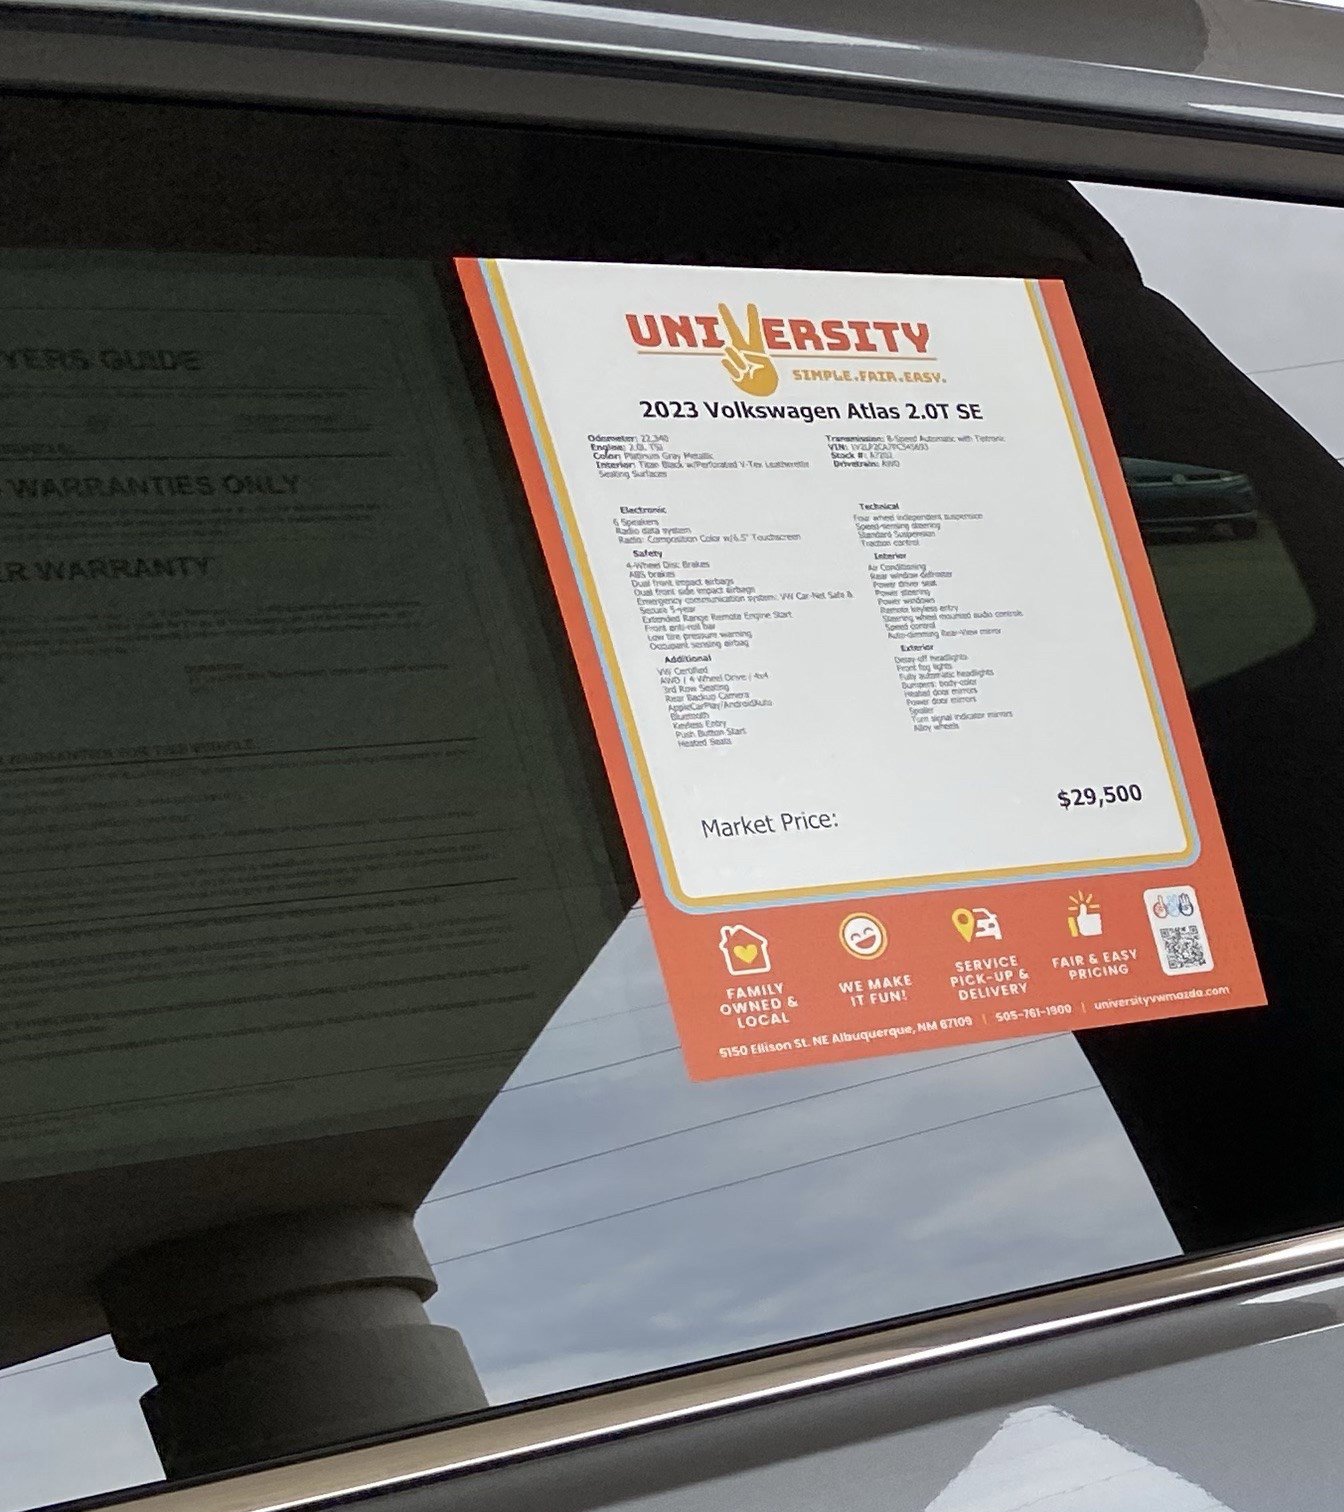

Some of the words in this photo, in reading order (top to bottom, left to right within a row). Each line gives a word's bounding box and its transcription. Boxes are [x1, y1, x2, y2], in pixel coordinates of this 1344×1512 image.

[100, 349, 201, 371] GUIDE
[639, 400, 699, 418] 2023
[703, 401, 841, 423] Volkswagen
[847, 402, 900, 419] Atlas
[905, 403, 949, 419] 2.0T
[957, 404, 983, 419] SE
[7, 476, 215, 499] WARRANTIES
[222, 473, 300, 495] ONLY
[620, 506, 666, 514] Electronic
[621, 518, 659, 527] Speakers
[700, 534, 720, 542] Color
[633, 550, 662, 558] Safety
[34, 556, 211, 581] WARRANTY
[665, 655, 711, 663] Additional
[701, 813, 775, 839] Market
[781, 813, 839, 832] Price:
[1058, 784, 1142, 810] $29,500
[955, 956, 1017, 972] SERVICE
[1052, 956, 1084, 968] FAIR
[1089, 953, 1098, 964] &
[1103, 950, 1138, 964] EASY
[950, 969, 1012, 987] PICK-UP
[1018, 968, 1029, 980] &
[1069, 964, 1128, 980] PRICING
[726, 982, 784, 999] FAMILY
[839, 980, 863, 993] WE
[868, 975, 912, 990] MAKE
[959, 982, 1028, 1001] DELIVERY
[720, 998, 781, 1015] OWNED
[787, 996, 798, 1008] &
[850, 995, 864, 1007] IT
[870, 989, 906, 1004] FUN!
[737, 1012, 790, 1029] LOCAL
[719, 1046, 748, 1058] 5150
[751, 1040, 792, 1054] Ellison
[794, 1037, 809, 1049] St.
[813, 1034, 829, 1045] NE
[832, 1024, 916, 1044] Albuquerque,
[917, 1019, 938, 1032] NM
